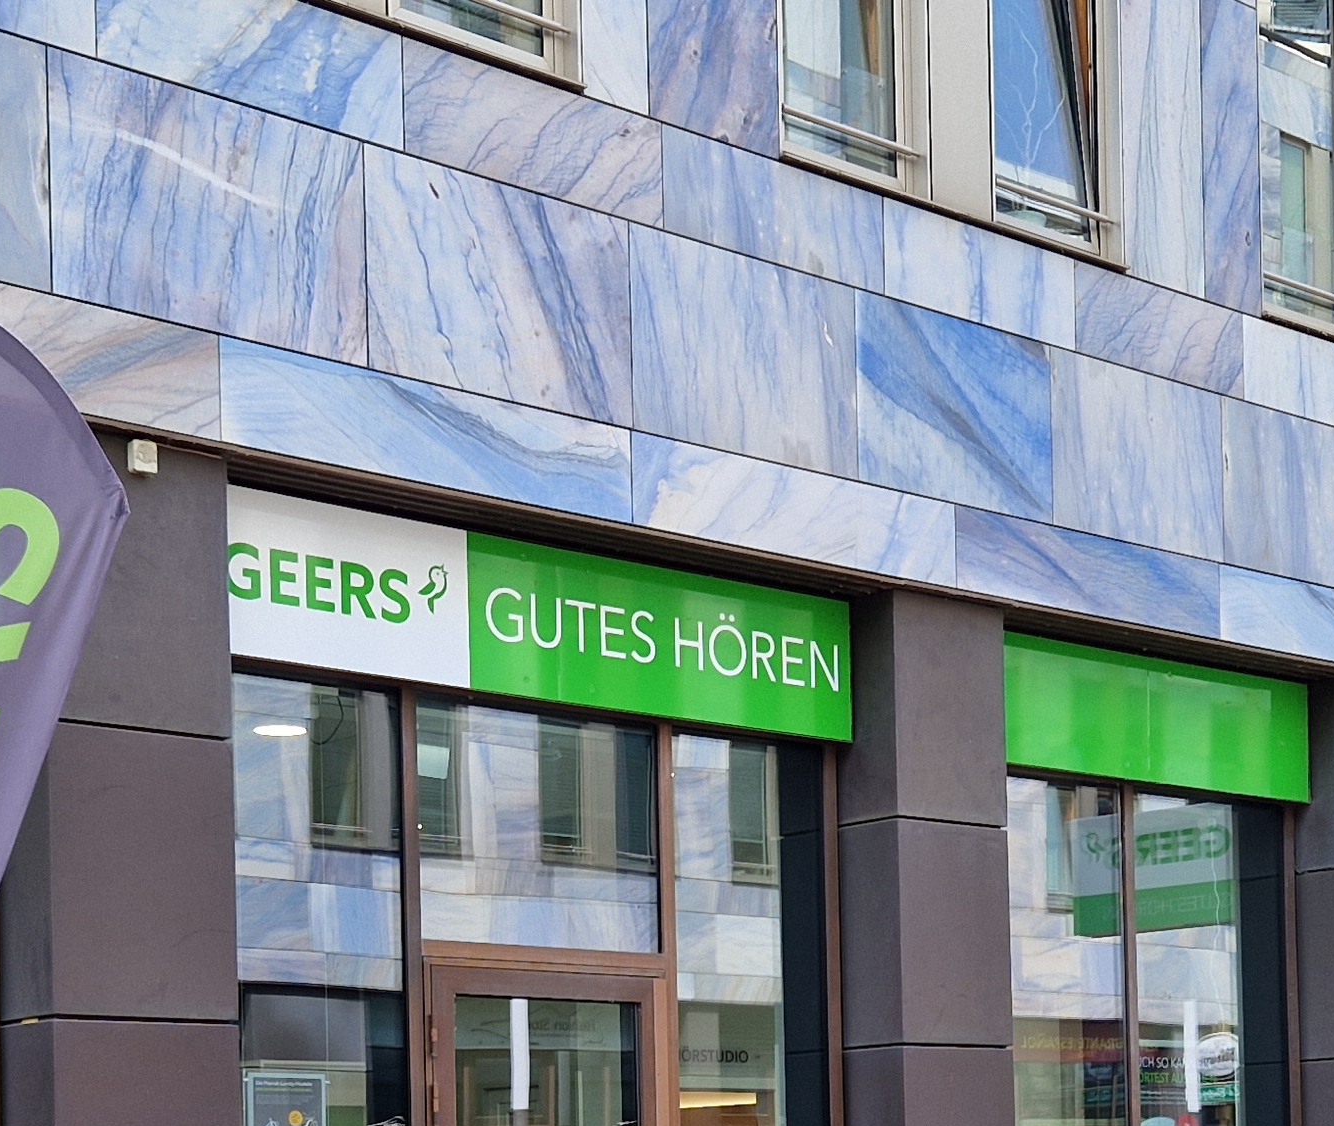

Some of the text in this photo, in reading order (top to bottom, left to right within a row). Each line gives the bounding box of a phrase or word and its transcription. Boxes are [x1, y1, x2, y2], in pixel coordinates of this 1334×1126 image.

[228, 541, 841, 692] GEERS GUTES HÖREN
